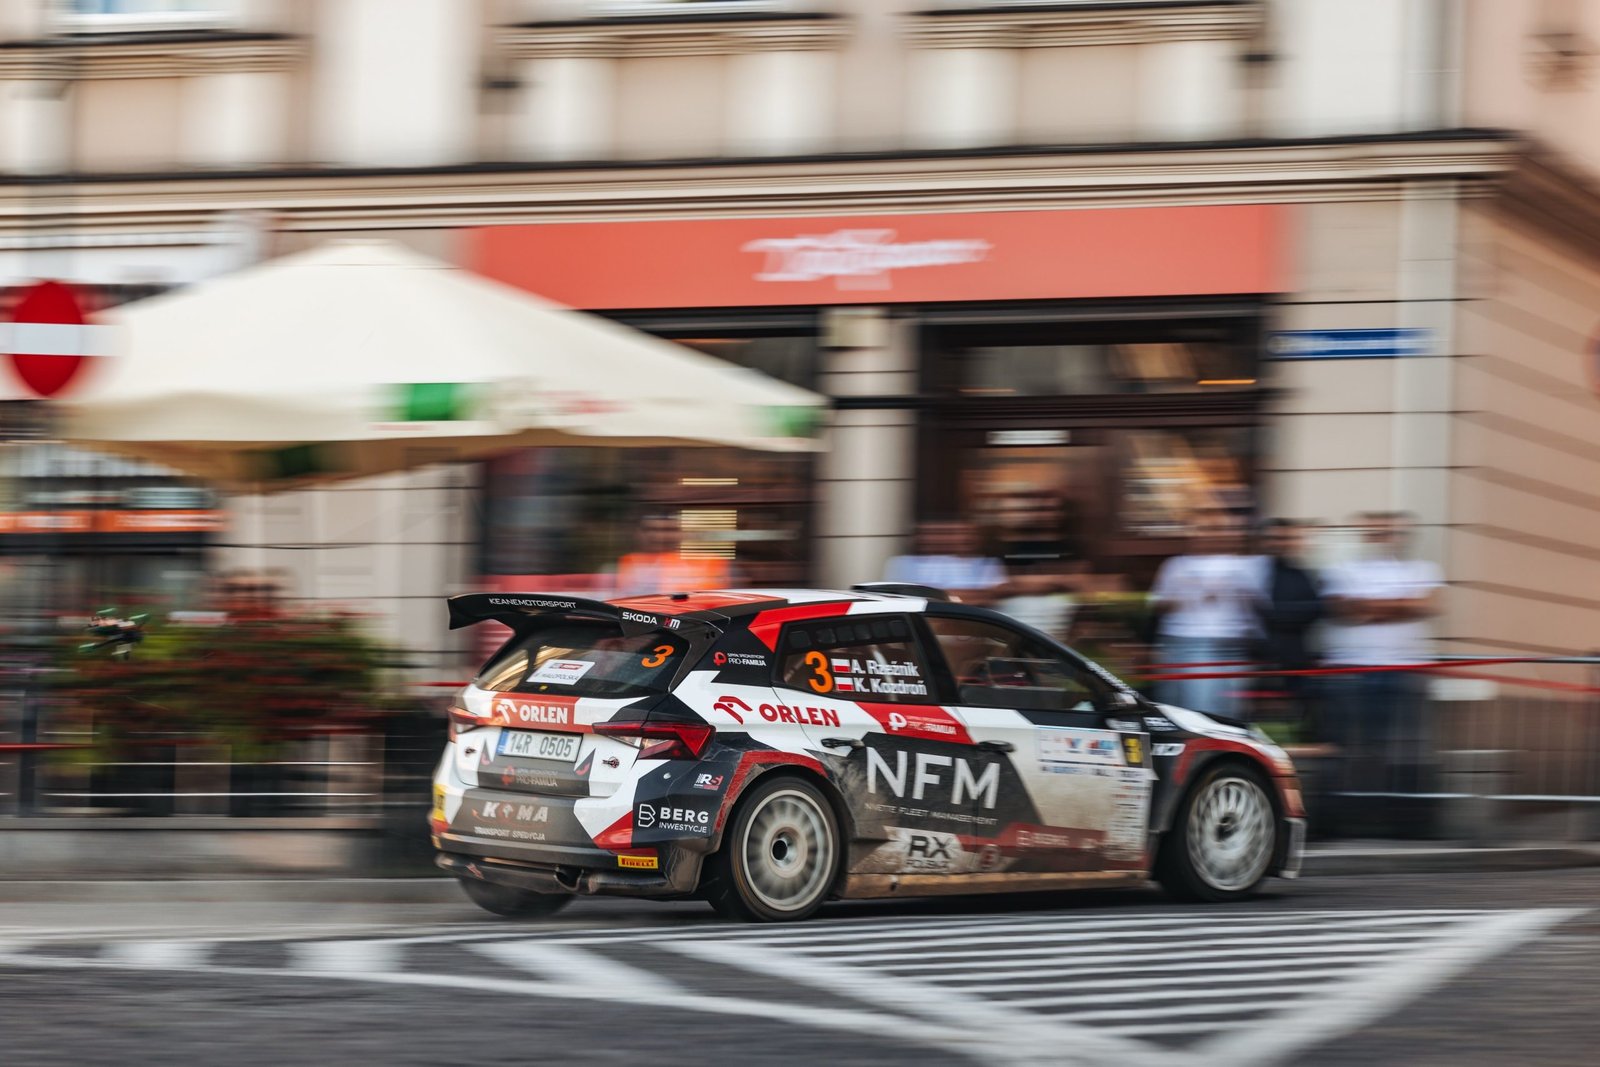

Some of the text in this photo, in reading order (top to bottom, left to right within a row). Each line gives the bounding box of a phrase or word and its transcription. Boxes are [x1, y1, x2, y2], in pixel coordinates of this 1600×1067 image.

[488, 598, 577, 609] KEANEMOTORSPORT
[641, 645, 674, 668] 3
[851, 659, 866, 674] A.
[805, 651, 833, 693] 3
[853, 677, 870, 693] K.
[519, 706, 568, 724] ORLEN
[758, 703, 841, 728] ORLEN
[510, 733, 573, 757] 14R 0505
[866, 746, 1001, 810] NFM
[660, 807, 709, 824] BERG
[659, 822, 708, 833] INWESTYCJE
[908, 835, 952, 859] RX
